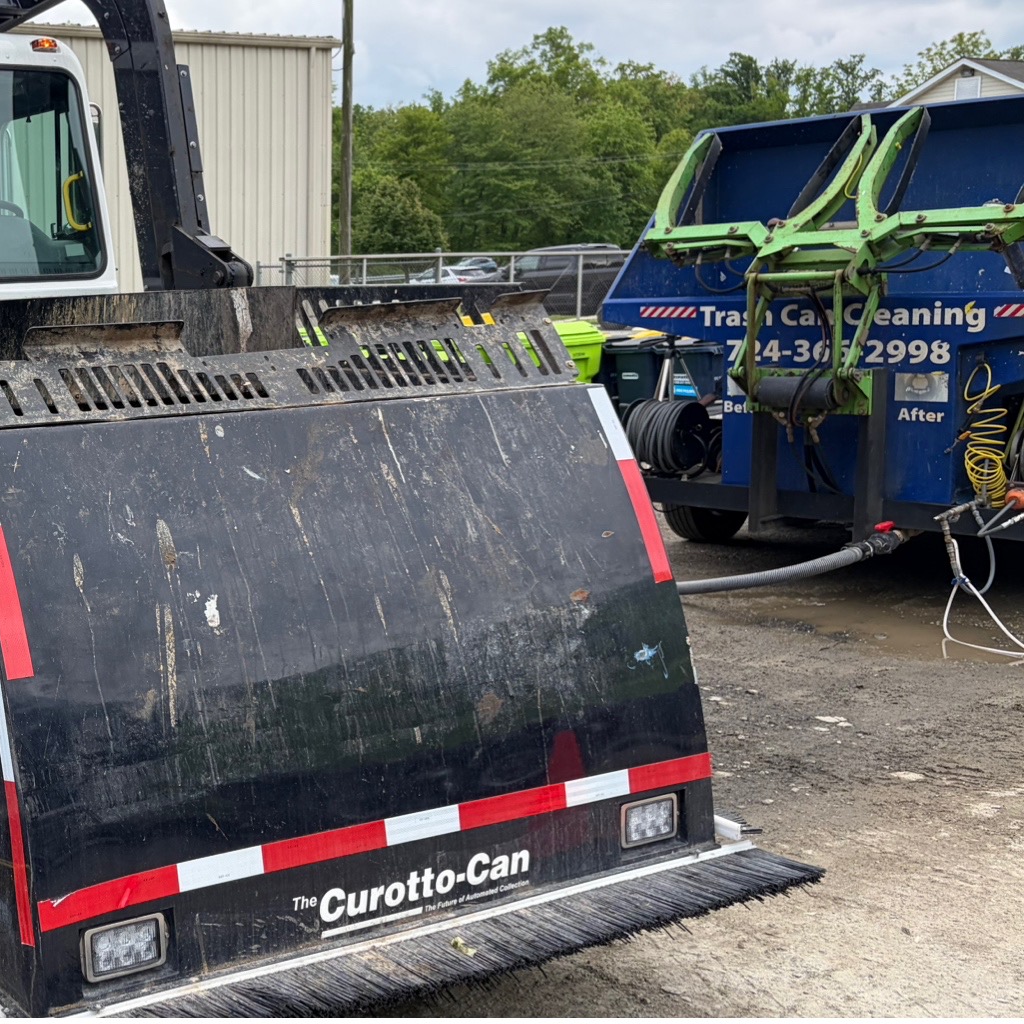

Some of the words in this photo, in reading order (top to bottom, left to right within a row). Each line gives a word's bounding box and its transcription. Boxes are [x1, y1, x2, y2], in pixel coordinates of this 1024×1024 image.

[843, 300, 986, 333] Ceaning
[897, 407, 945, 423] After
[292, 895, 317, 912] The
[319, 849, 530, 923] Curotto-Can
[425, 903, 436, 912] The
[437, 898, 457, 910] Future
[465, 886, 498, 902] Automated
[499, 879, 530, 893] Collection
